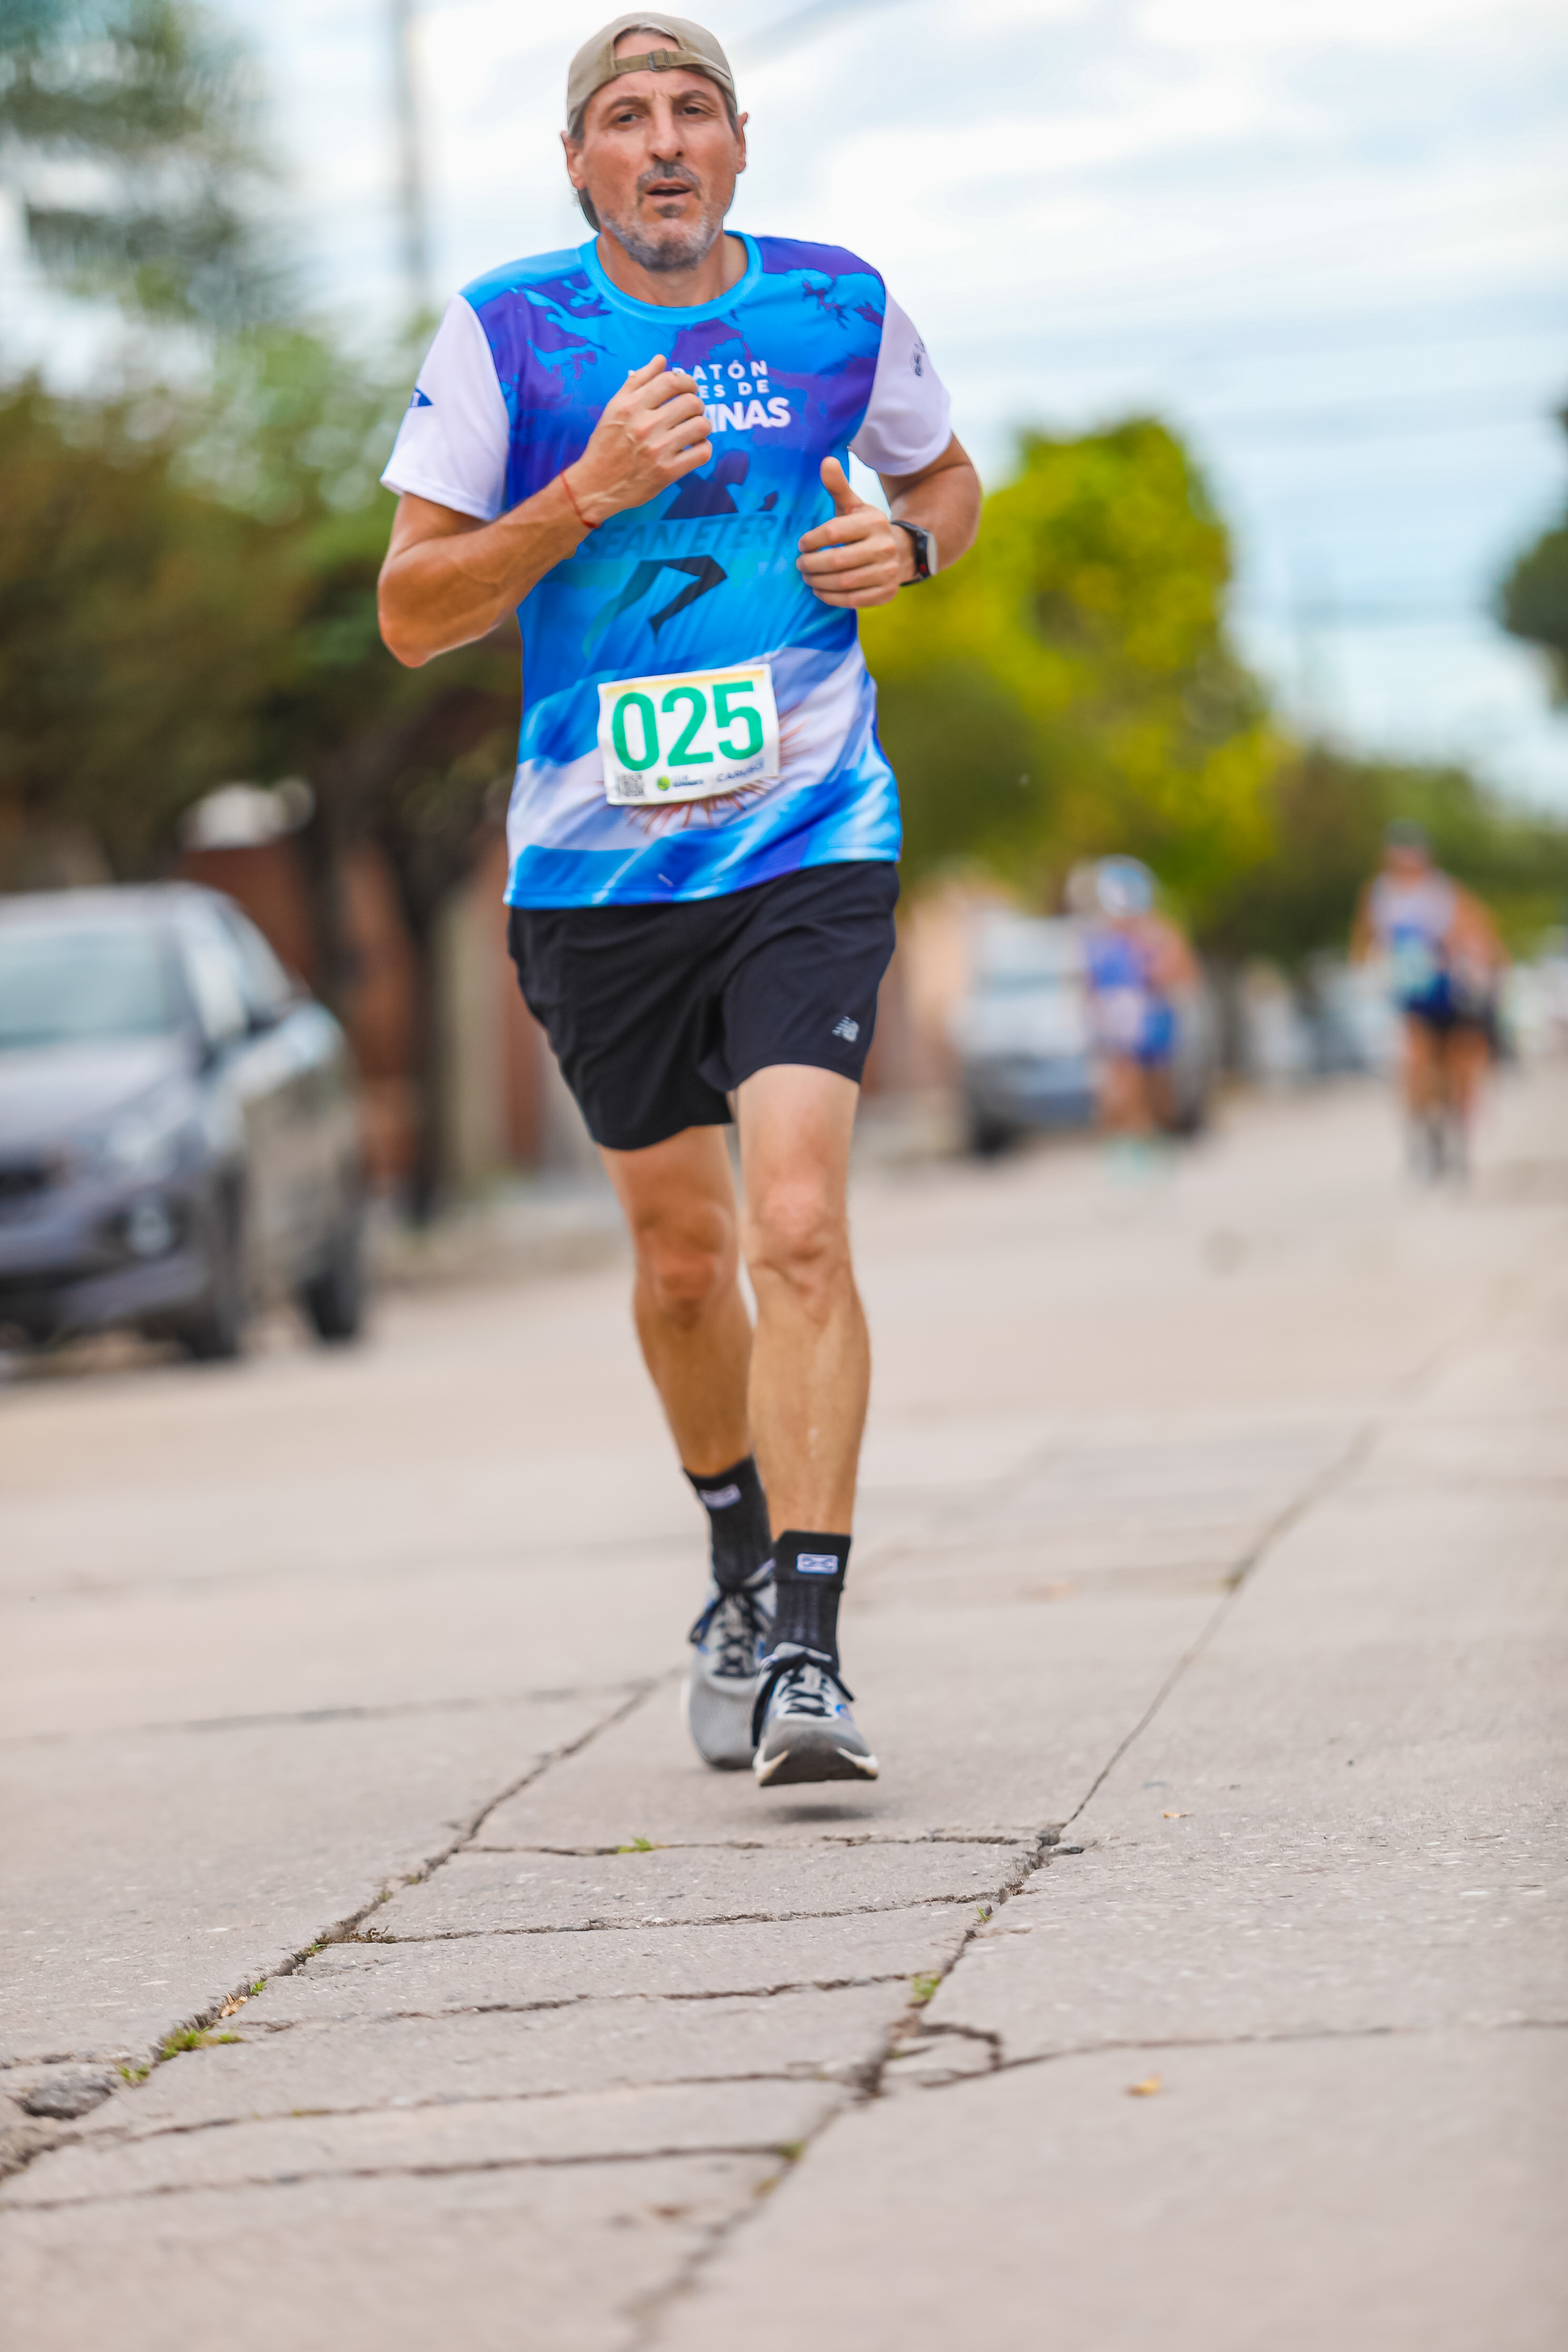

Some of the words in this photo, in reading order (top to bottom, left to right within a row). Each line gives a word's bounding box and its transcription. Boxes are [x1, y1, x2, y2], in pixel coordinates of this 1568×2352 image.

[628, 360, 768, 380] ATÓN
[738, 379, 770, 396] DE
[703, 396, 791, 433] INAS
[612, 681, 763, 771] 025
